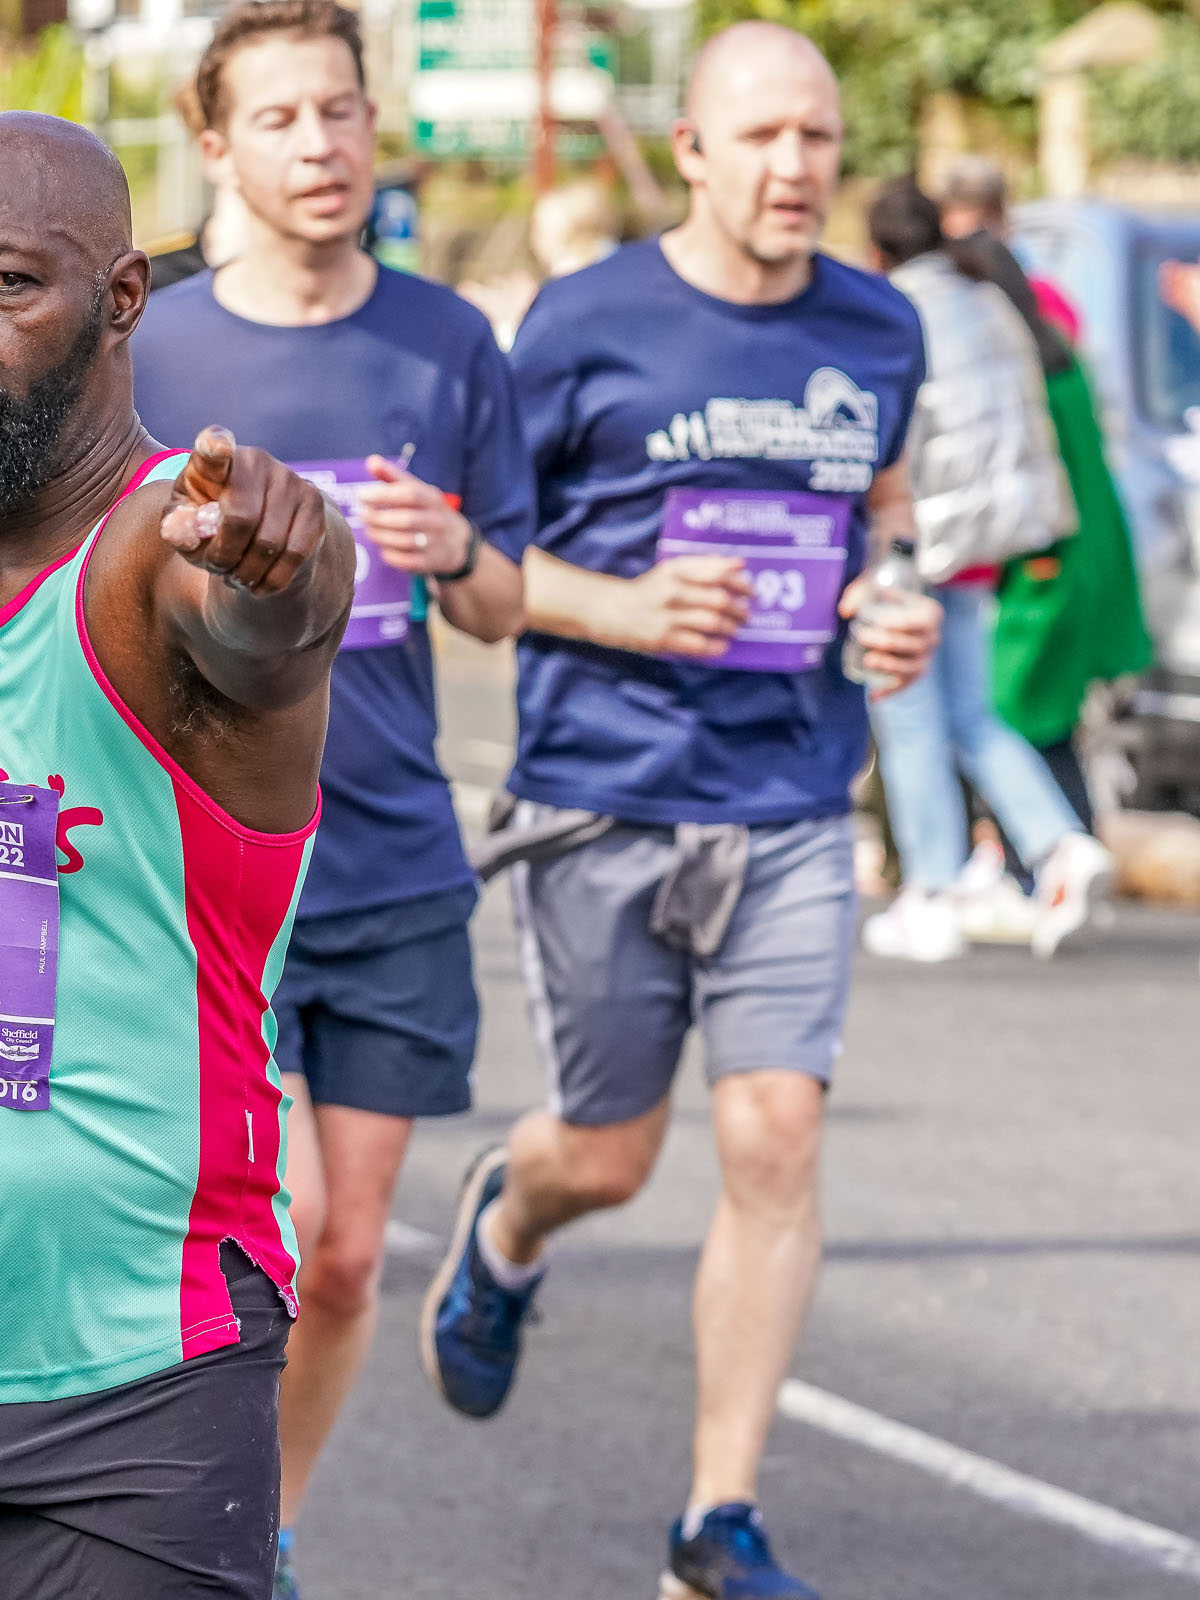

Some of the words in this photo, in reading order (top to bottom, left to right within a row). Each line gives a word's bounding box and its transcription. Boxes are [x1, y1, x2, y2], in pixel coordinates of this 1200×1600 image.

[742, 569, 805, 612] 93
[40, 919, 48, 956] CAMPBELL
[38, 957, 46, 974] PAUL
[1, 1027, 38, 1039] Sheffield
